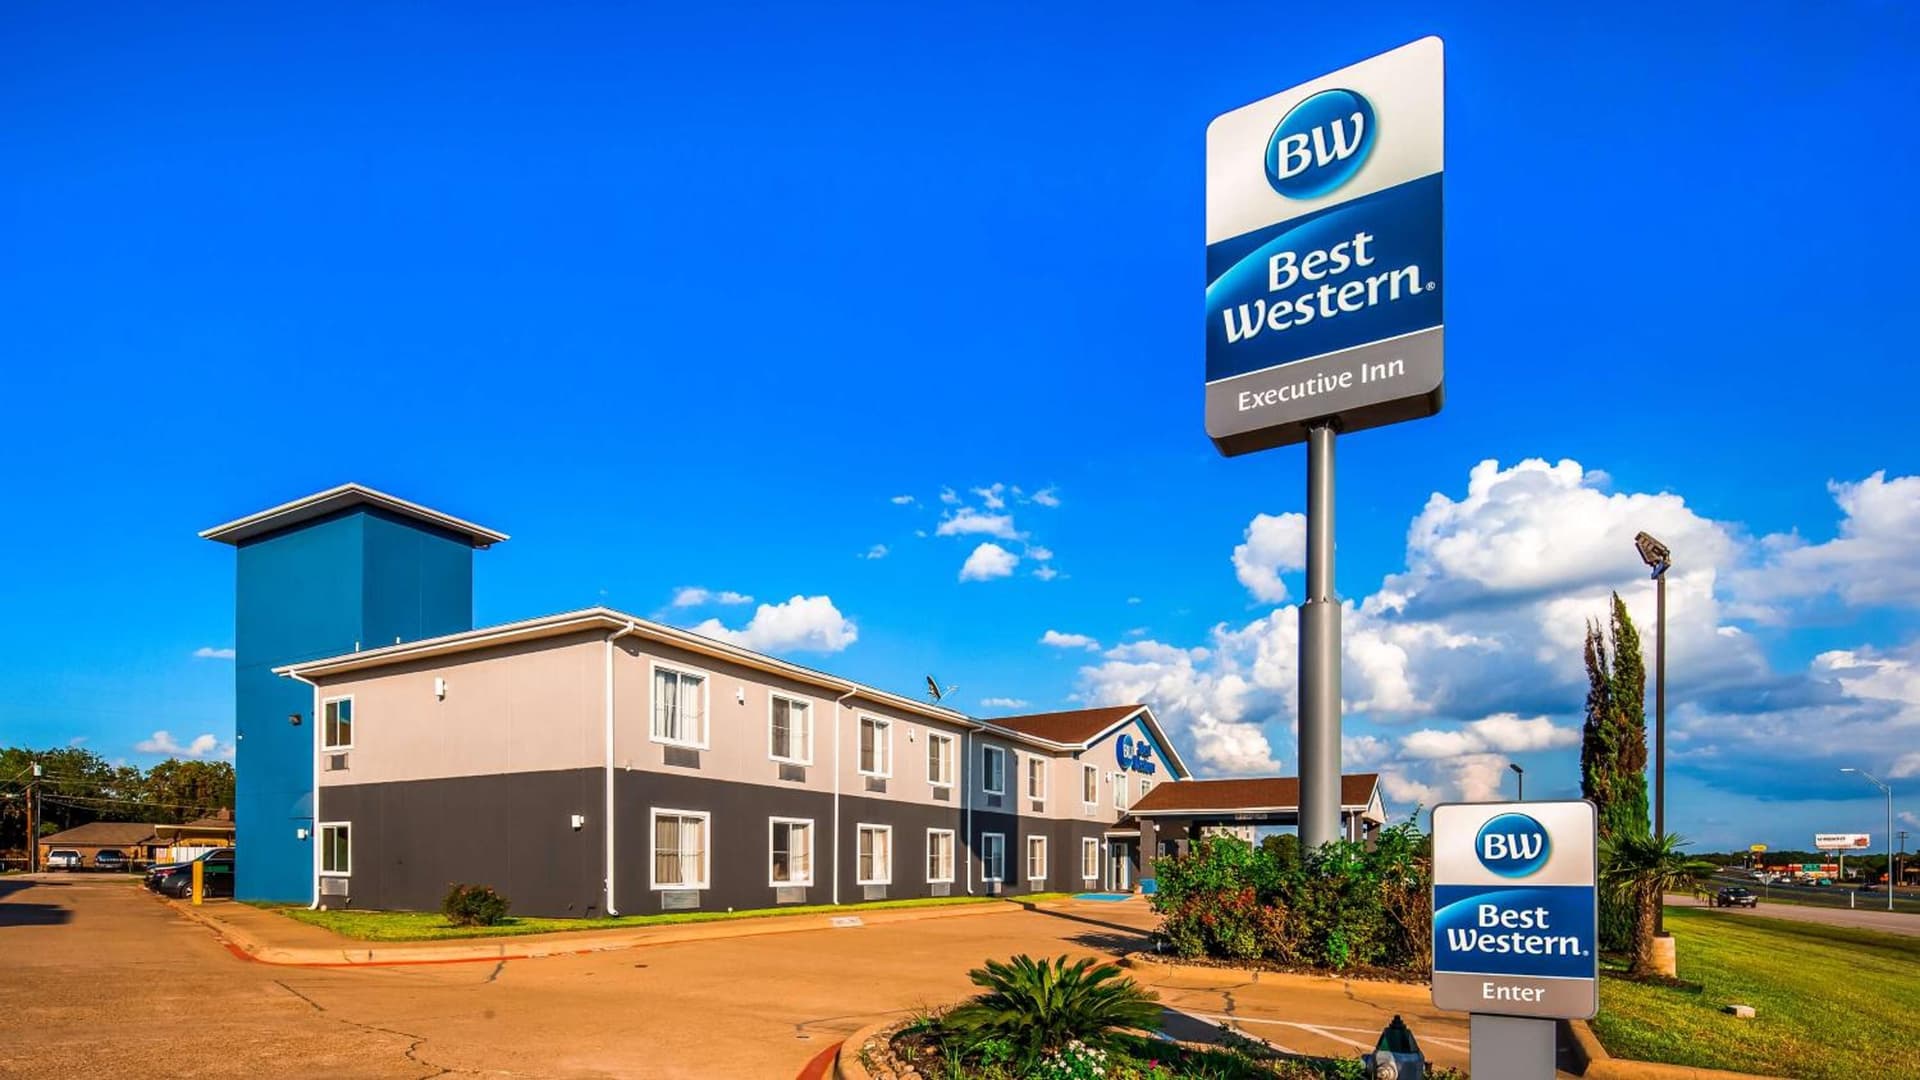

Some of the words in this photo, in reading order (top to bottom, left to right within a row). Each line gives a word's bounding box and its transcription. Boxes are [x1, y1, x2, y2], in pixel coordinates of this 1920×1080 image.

[1277, 111, 1364, 180] BW
[1268, 231, 1375, 292] Best
[1223, 264, 1423, 343] Western
[1237, 370, 1353, 412] Executive
[1361, 358, 1405, 384] Inn
[1484, 833, 1543, 860] BW
[1478, 904, 1550, 929] Best
[1447, 928, 1581, 956] Western
[1482, 982, 1545, 1002] Enter
